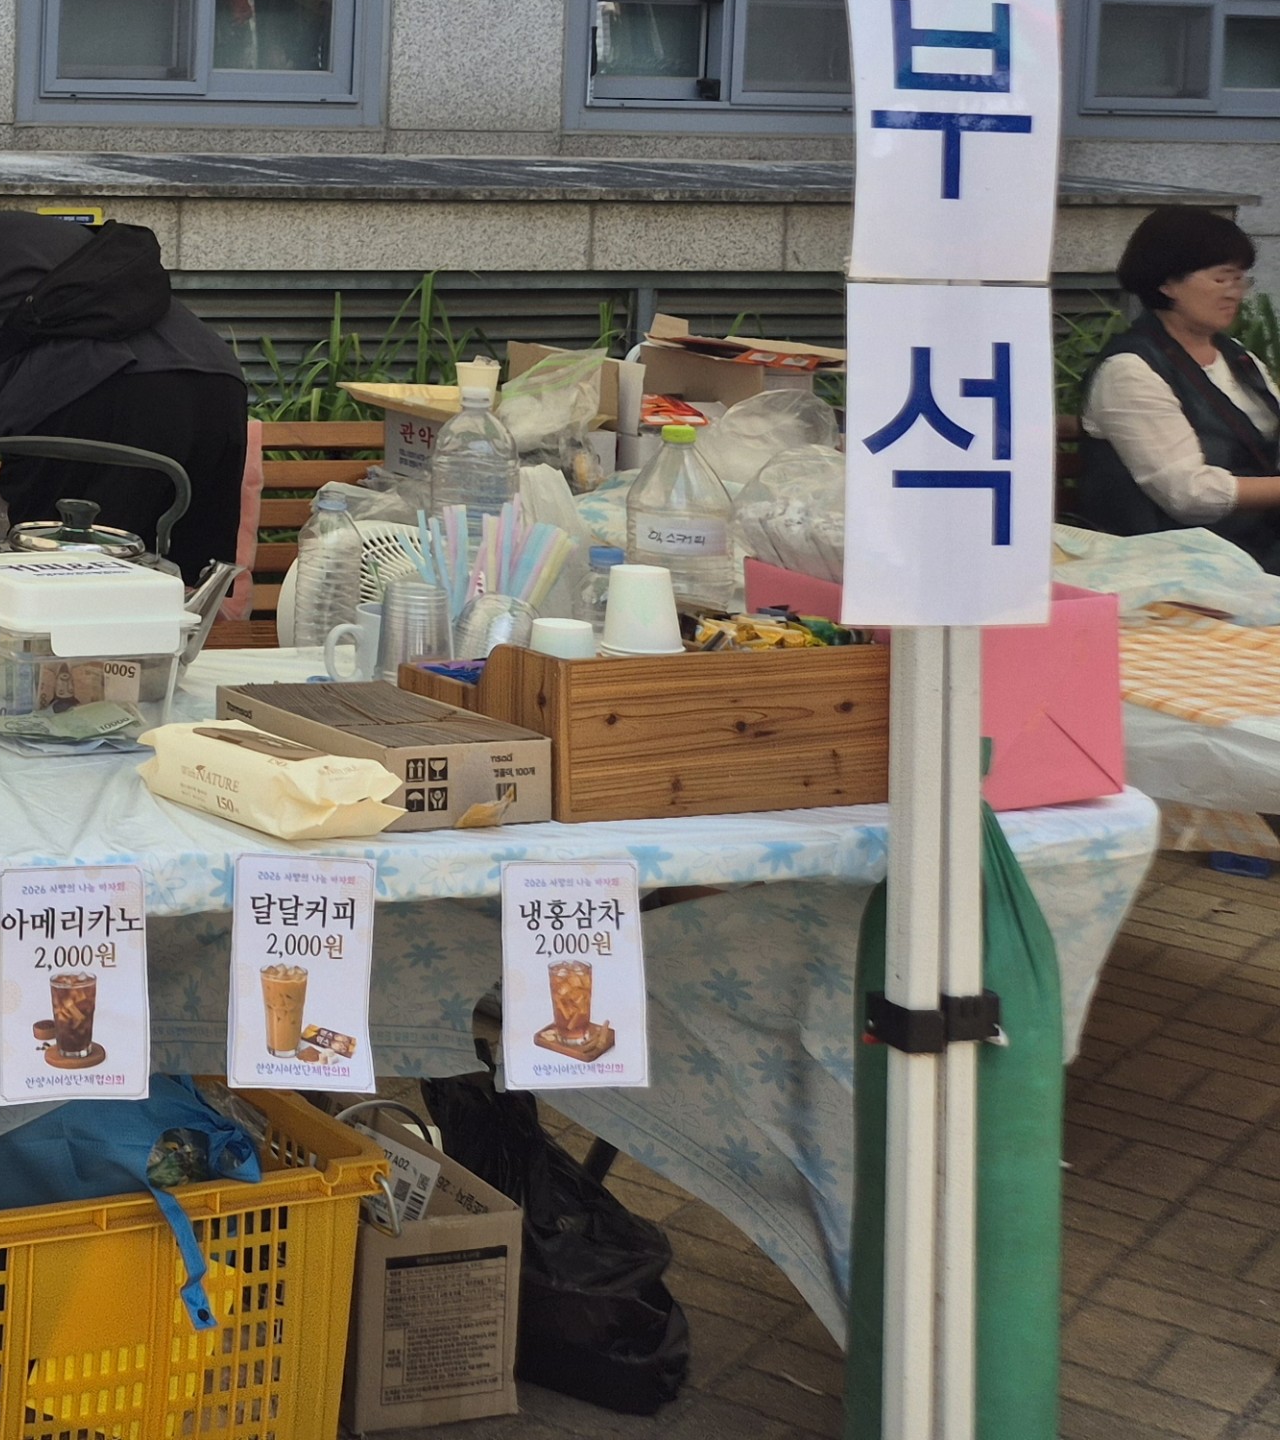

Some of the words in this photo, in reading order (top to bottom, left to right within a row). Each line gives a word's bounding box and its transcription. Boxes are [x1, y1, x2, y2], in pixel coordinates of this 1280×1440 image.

[104, 662, 136, 679] 5000
[1, 904, 144, 941] 아메리카노
[250, 892, 356, 930] 달달커피
[518, 898, 625, 931] 냉홍삼차
[34, 942, 117, 971] 2,000원
[266, 932, 344, 960] 2,000원
[534, 930, 613, 957] 2,000원
